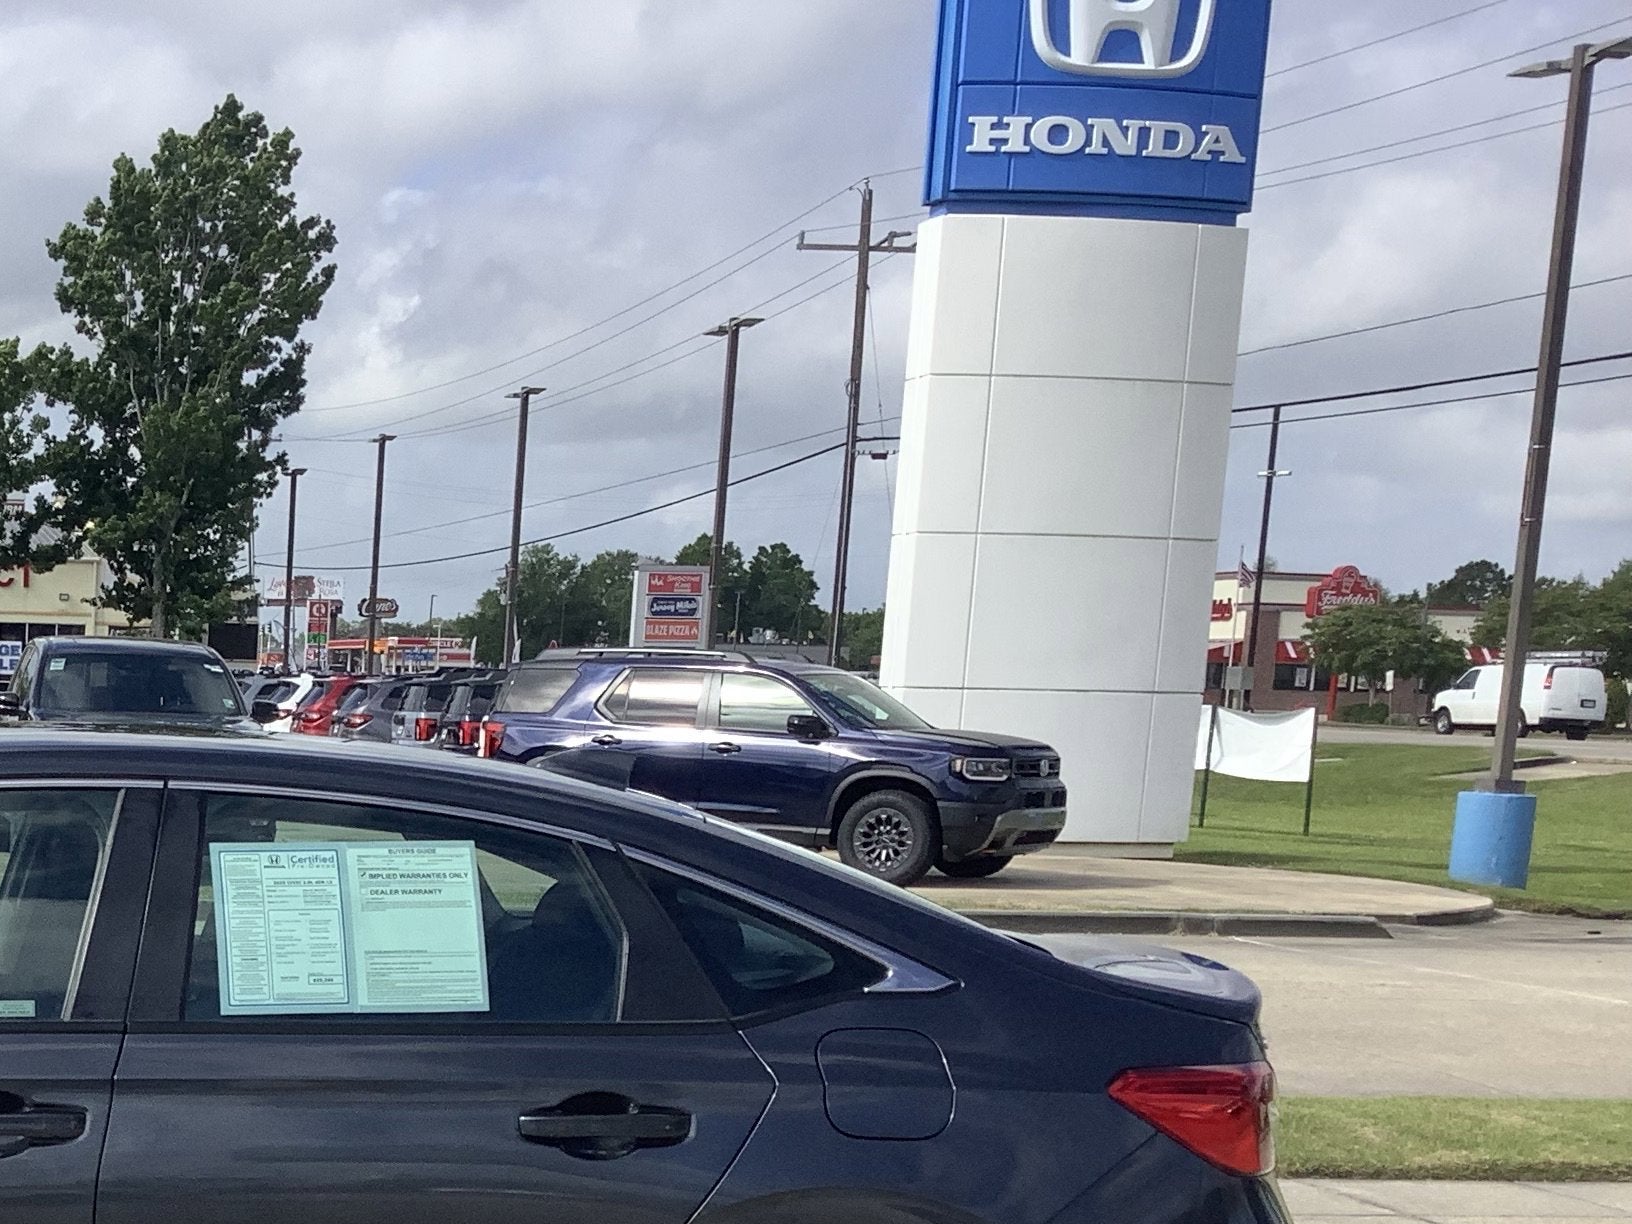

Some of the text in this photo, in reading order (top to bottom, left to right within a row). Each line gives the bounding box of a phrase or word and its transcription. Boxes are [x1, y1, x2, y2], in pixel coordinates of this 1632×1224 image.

[964, 114, 1247, 164] HONDA
[646, 625, 690, 636] BLAZE PIZZA
[290, 854, 335, 864] Certified
[370, 888, 400, 896] DEALER
